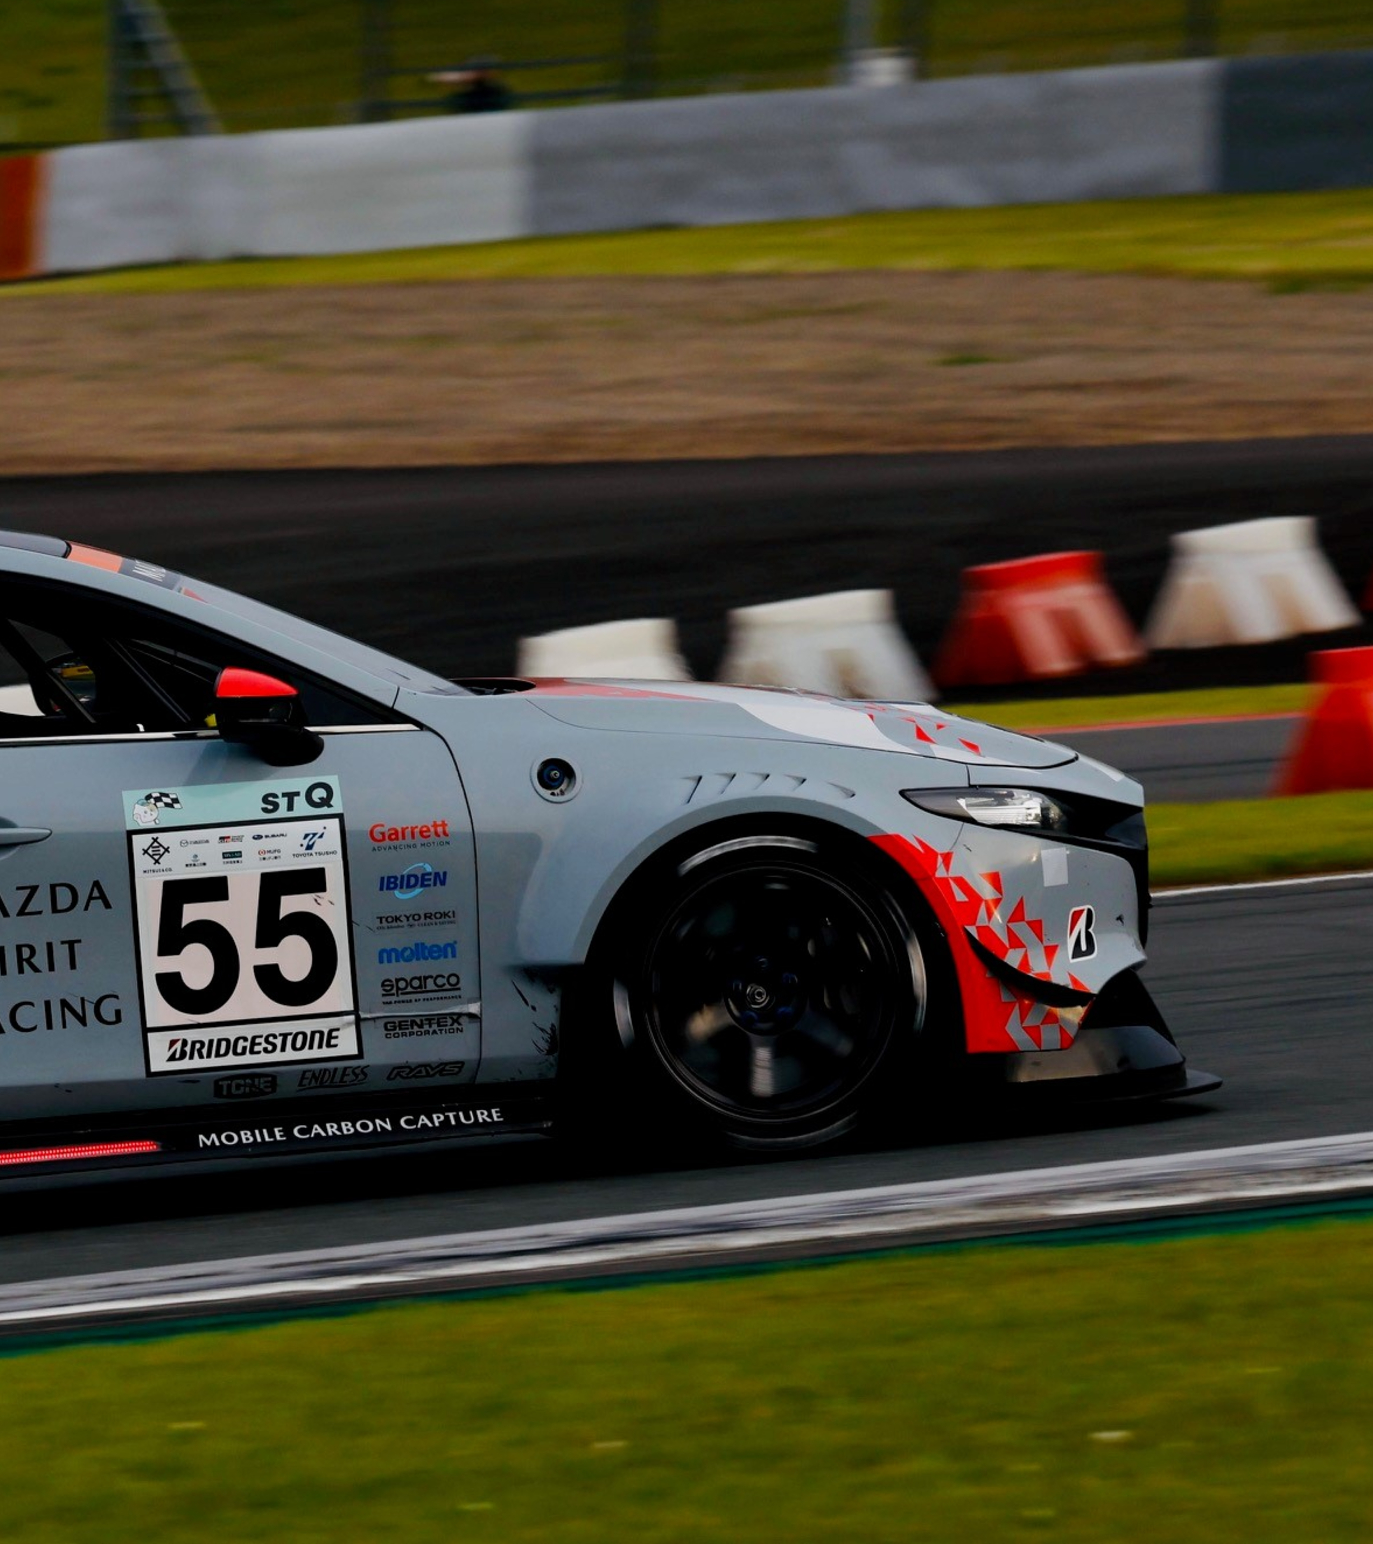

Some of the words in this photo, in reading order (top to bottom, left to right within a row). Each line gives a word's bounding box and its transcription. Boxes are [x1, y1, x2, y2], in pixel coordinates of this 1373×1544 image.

[369, 820, 450, 843] Garrett
[372, 843, 417, 852] ADVANCING
[420, 840, 451, 848] MOTION
[379, 871, 447, 891] IBIDEN
[376, 913, 422, 925] TOKYO
[423, 910, 456, 921] ROKI
[155, 867, 339, 1015] 55
[378, 942, 457, 964] molten
[381, 973, 460, 997] sparco
[384, 1015, 463, 1031] GENTEX
[385, 1027, 464, 1039] CORPORATION
[166, 1028, 341, 1062] BRIDGESTONE
[297, 1065, 370, 1088] ENDLESS
[386, 1061, 465, 1080] RAYS
[197, 1126, 287, 1148] MOBILE
[292, 1117, 393, 1139] CARBON
[399, 1108, 505, 1130] CAPTURE
